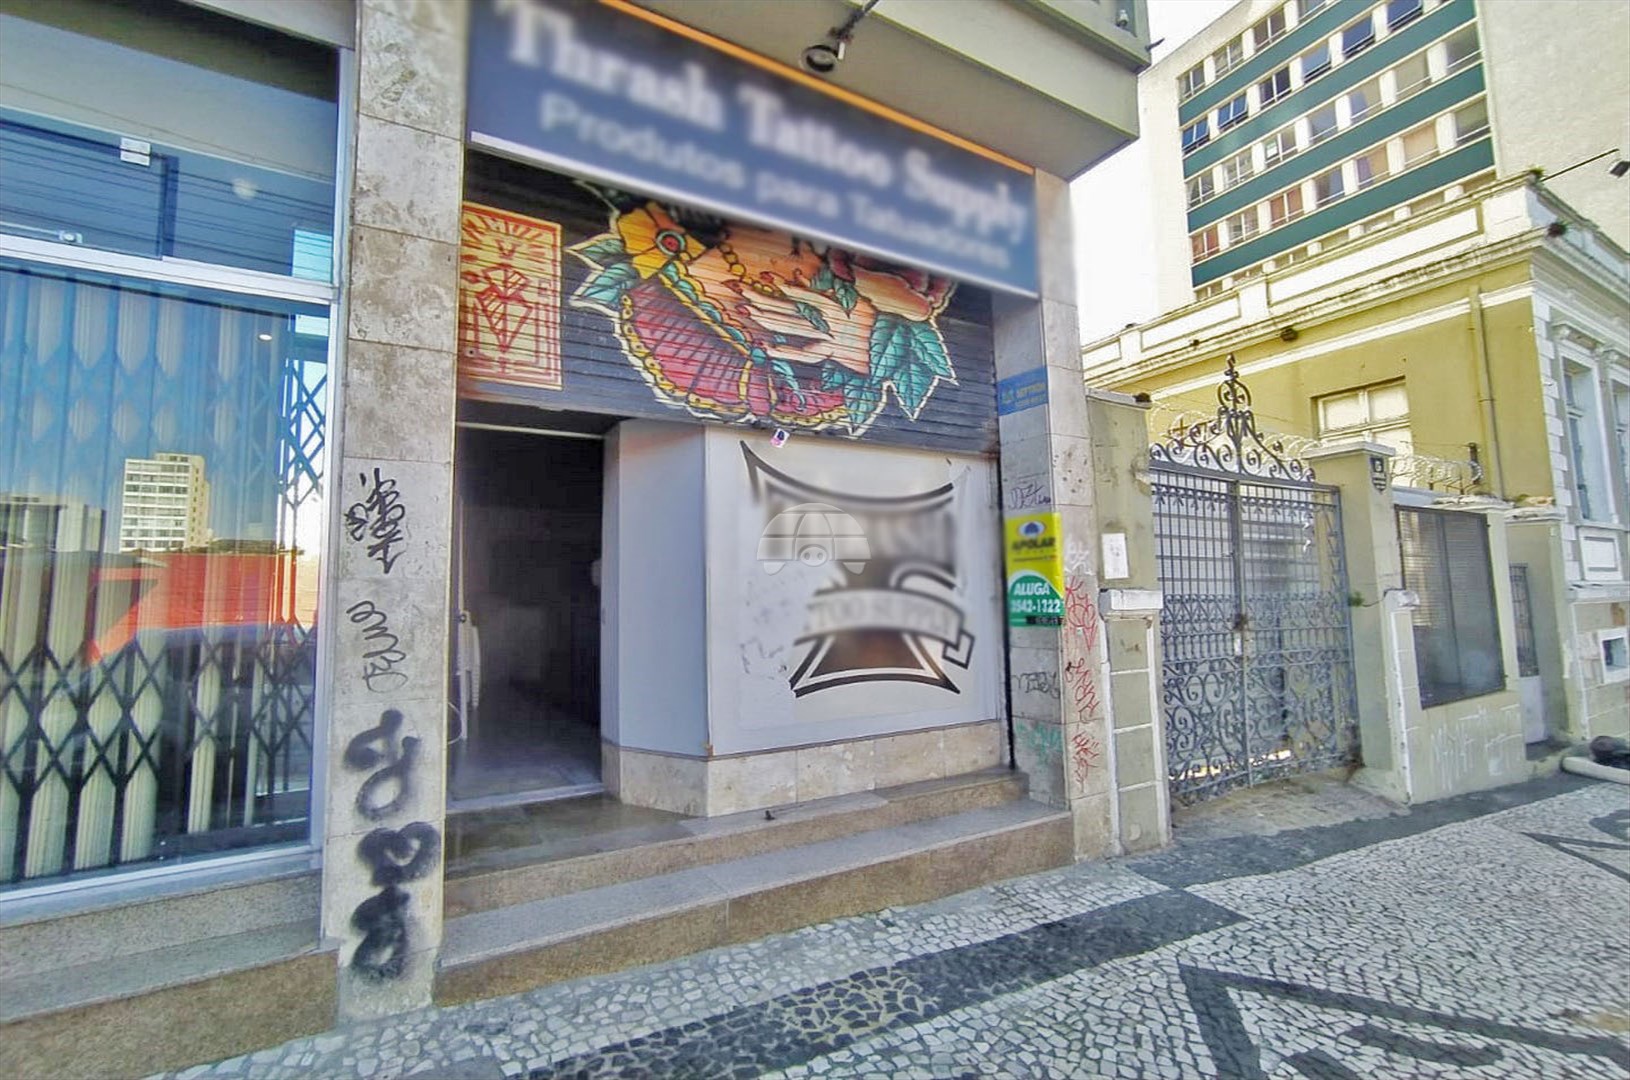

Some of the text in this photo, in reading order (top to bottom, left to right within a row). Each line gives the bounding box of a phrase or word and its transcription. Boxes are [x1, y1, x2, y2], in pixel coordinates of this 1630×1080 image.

[495, 0, 726, 133] Thrash
[902, 147, 1027, 247] Supply
[540, 92, 747, 190] Produtos
[756, 170, 840, 221] para
[1013, 582, 1050, 596] ALUGA
